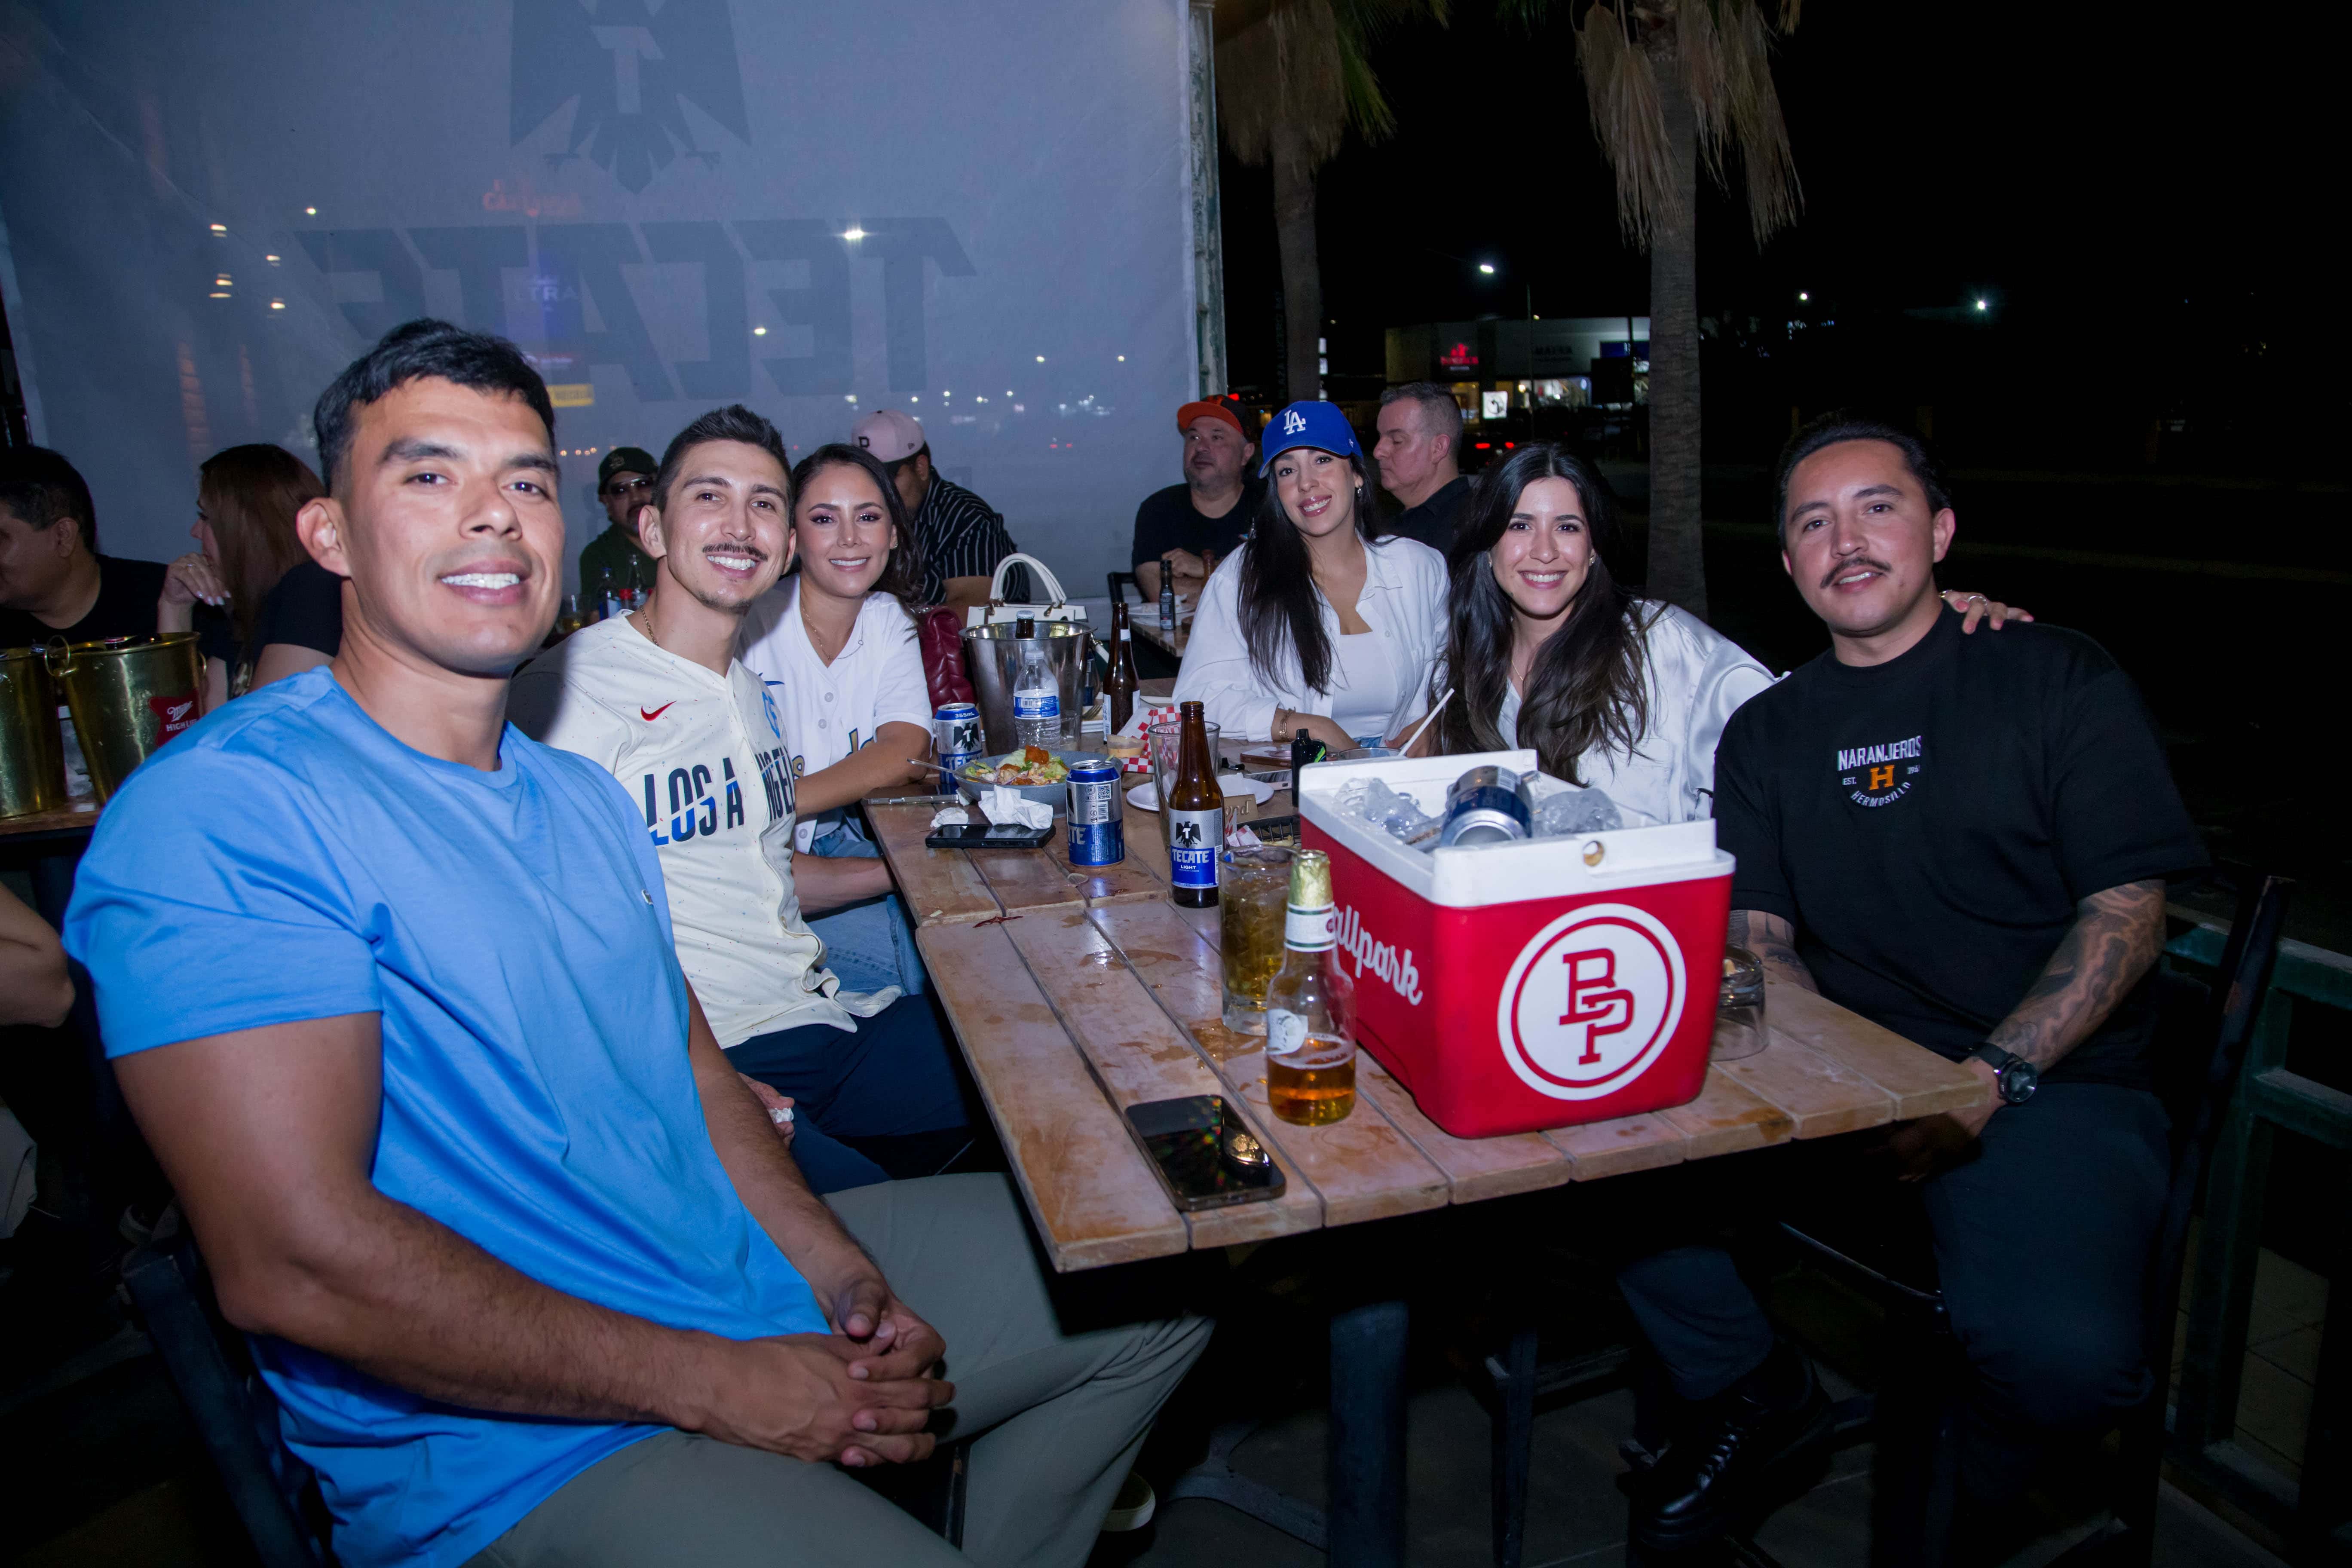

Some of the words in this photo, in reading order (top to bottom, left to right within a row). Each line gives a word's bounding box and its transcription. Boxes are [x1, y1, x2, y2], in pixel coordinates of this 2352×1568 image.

[1283, 409, 1306, 435] LA
[1838, 735, 1921, 771] NARANJEROS
[1842, 777, 1857, 785] EST.
[1869, 765, 1895, 790] H
[644, 764, 717, 846] LOS
[1850, 782, 1911, 807] HERMOSILLO
[1182, 828, 1191, 839] T
[1172, 848, 1210, 864] TECATE
[1333, 905, 1423, 1006] allpark
